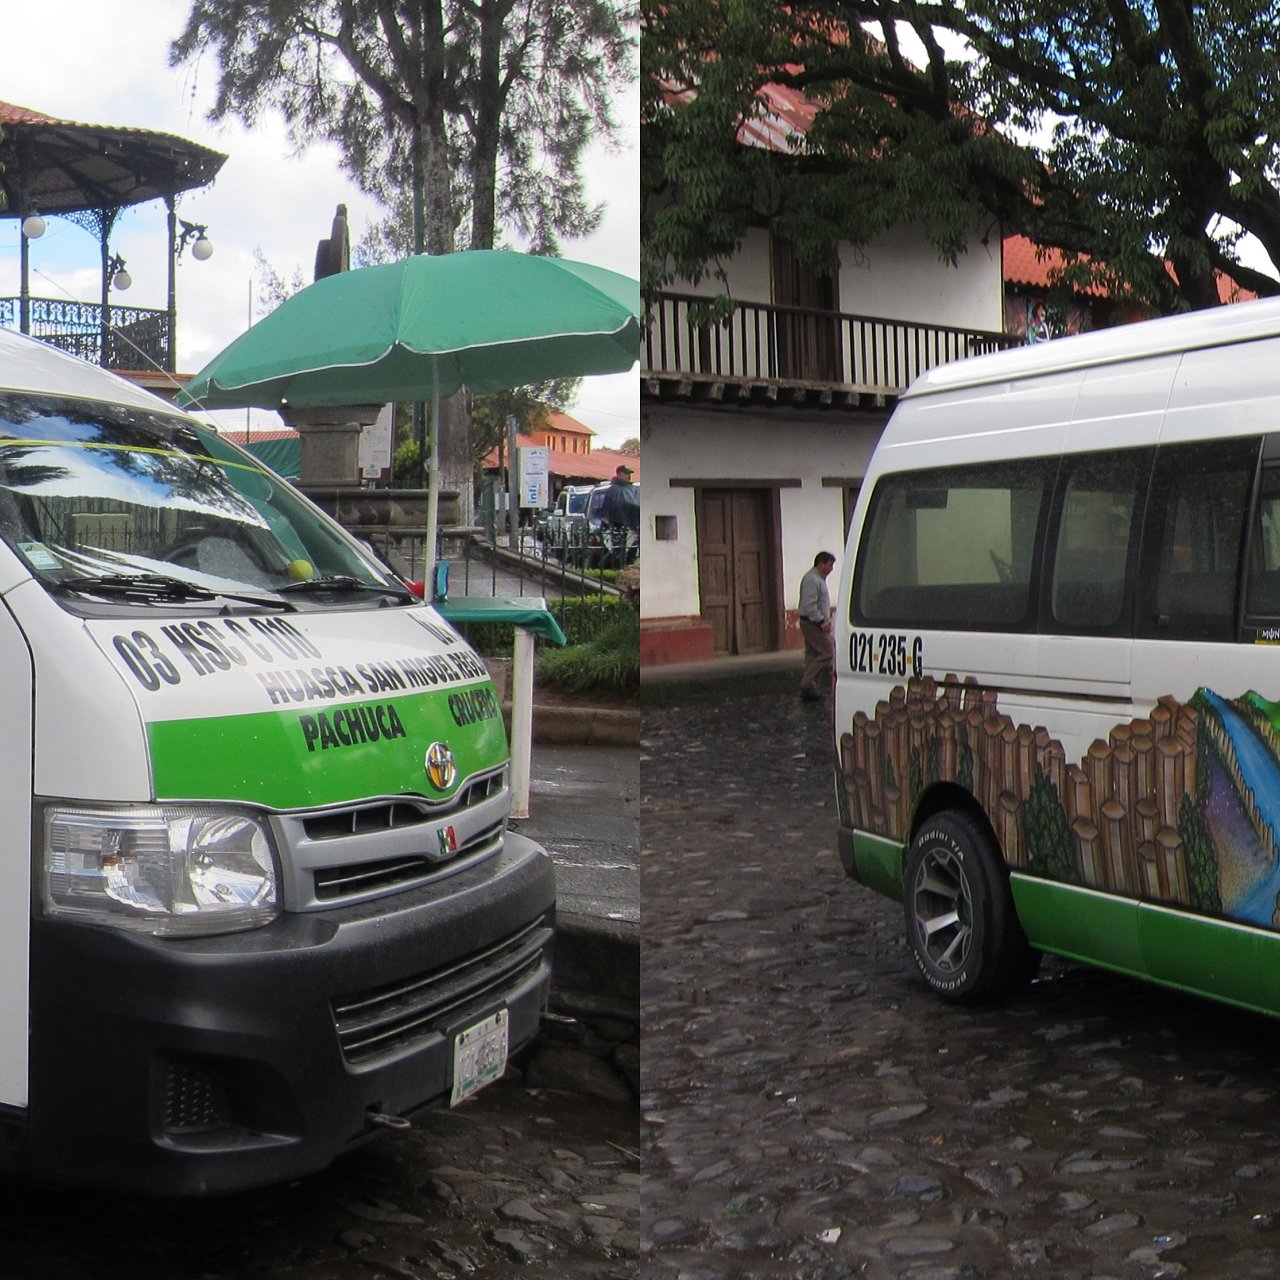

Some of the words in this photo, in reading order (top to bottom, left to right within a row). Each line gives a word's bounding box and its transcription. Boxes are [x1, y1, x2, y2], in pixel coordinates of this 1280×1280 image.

[112, 630, 181, 692] 03
[160, 620, 248, 677] HSC
[223, 618, 274, 663] C
[248, 617, 322, 661] 010
[256, 665, 366, 705] HUASCA
[354, 660, 408, 693] SAN
[400, 654, 461, 688] MIGUEL
[446, 649, 488, 680] REGL
[298, 704, 407, 752] PACHUCA
[918, 829, 948, 848] Radial
